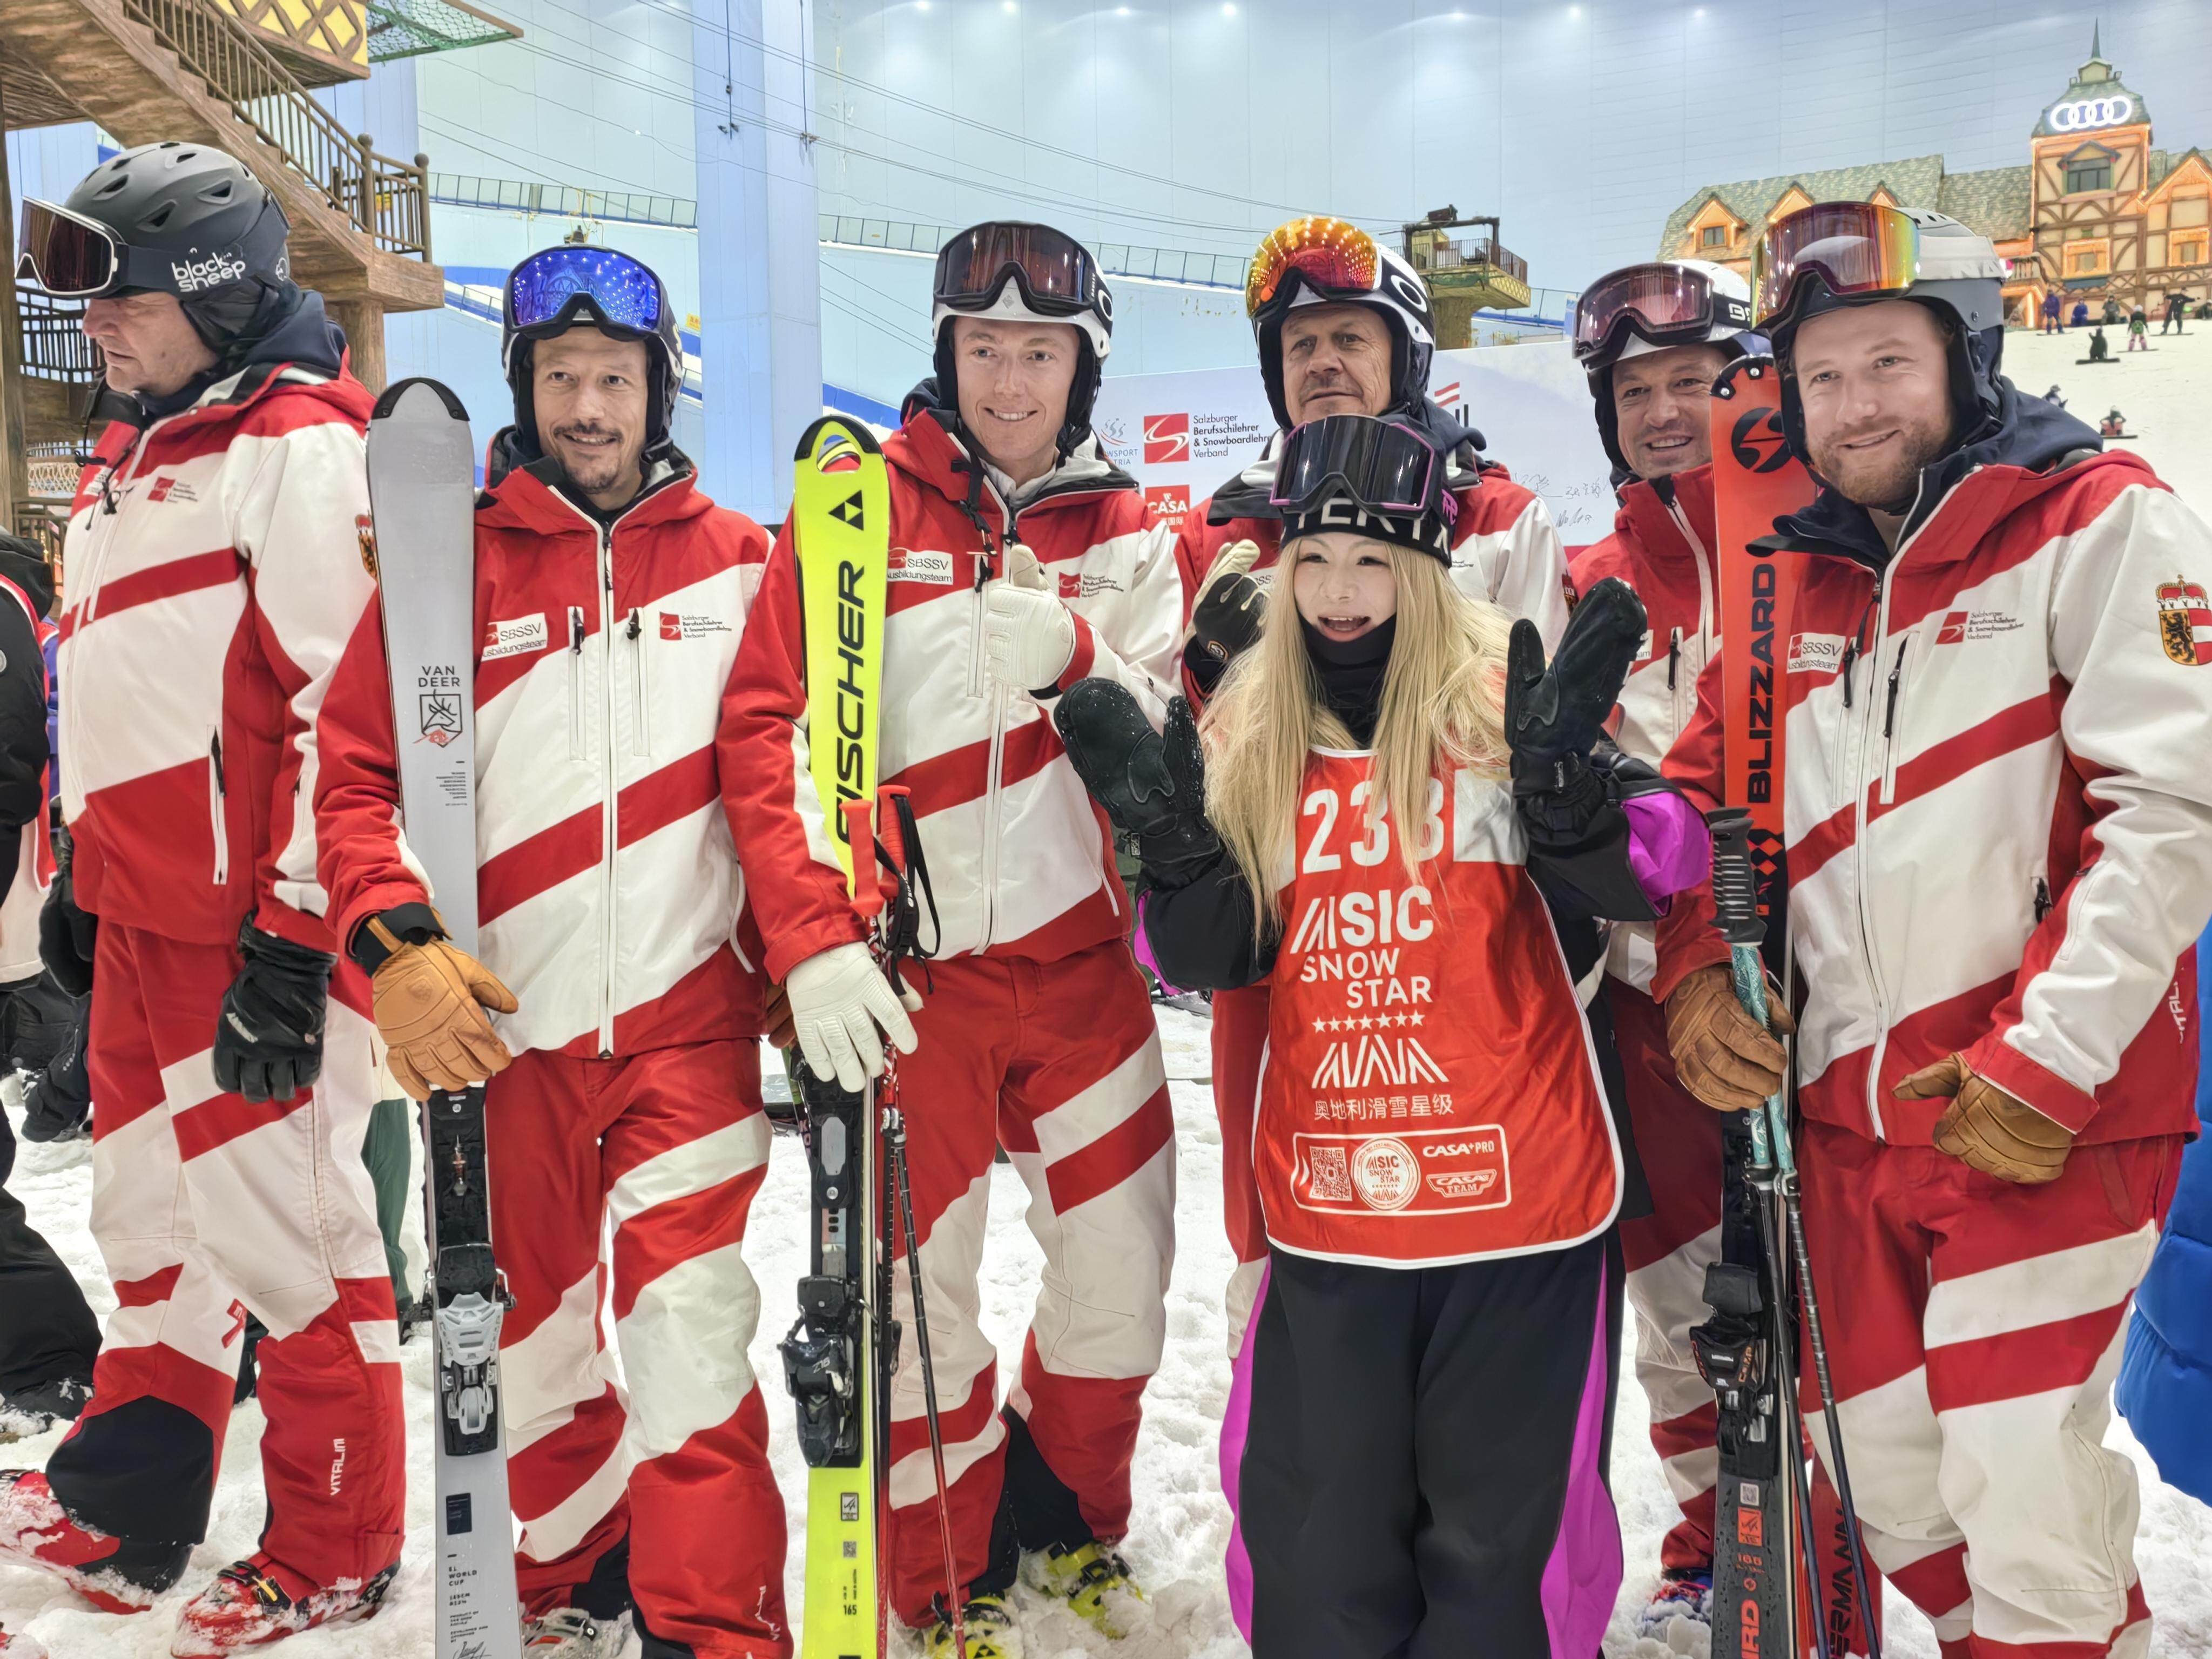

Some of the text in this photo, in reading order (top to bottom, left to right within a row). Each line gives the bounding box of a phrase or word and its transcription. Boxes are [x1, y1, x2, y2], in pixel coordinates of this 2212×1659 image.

[171, 252, 230, 281] black
[178, 260, 246, 292] sheep
[1193, 413, 1238, 424] Salzburger
[1193, 422, 1259, 435] Berufsschilehrer
[1193, 438, 1200, 447] &
[1106, 449, 1138, 457] WSPORT
[1193, 446, 1228, 458] Verband
[1148, 500, 1188, 515] CASA
[907, 557, 949, 570] SBSSV
[500, 622, 542, 642] SBSSV
[1803, 642, 1842, 657] SBSSV
[421, 665, 455, 676] VAN
[418, 677, 461, 687] DEER
[1748, 563, 1776, 804] BLIZZARD
[1300, 948, 1400, 983] SNOW
[1346, 975, 1434, 1009] STAR
[1314, 1094, 1454, 1121] 奥地利滑雪星级
[1447, 1183, 1477, 1193] TEAM
[449, 1570, 477, 1579] WORLD
[843, 1604, 857, 1615] 165
[1741, 1599, 1760, 1659] IRD
